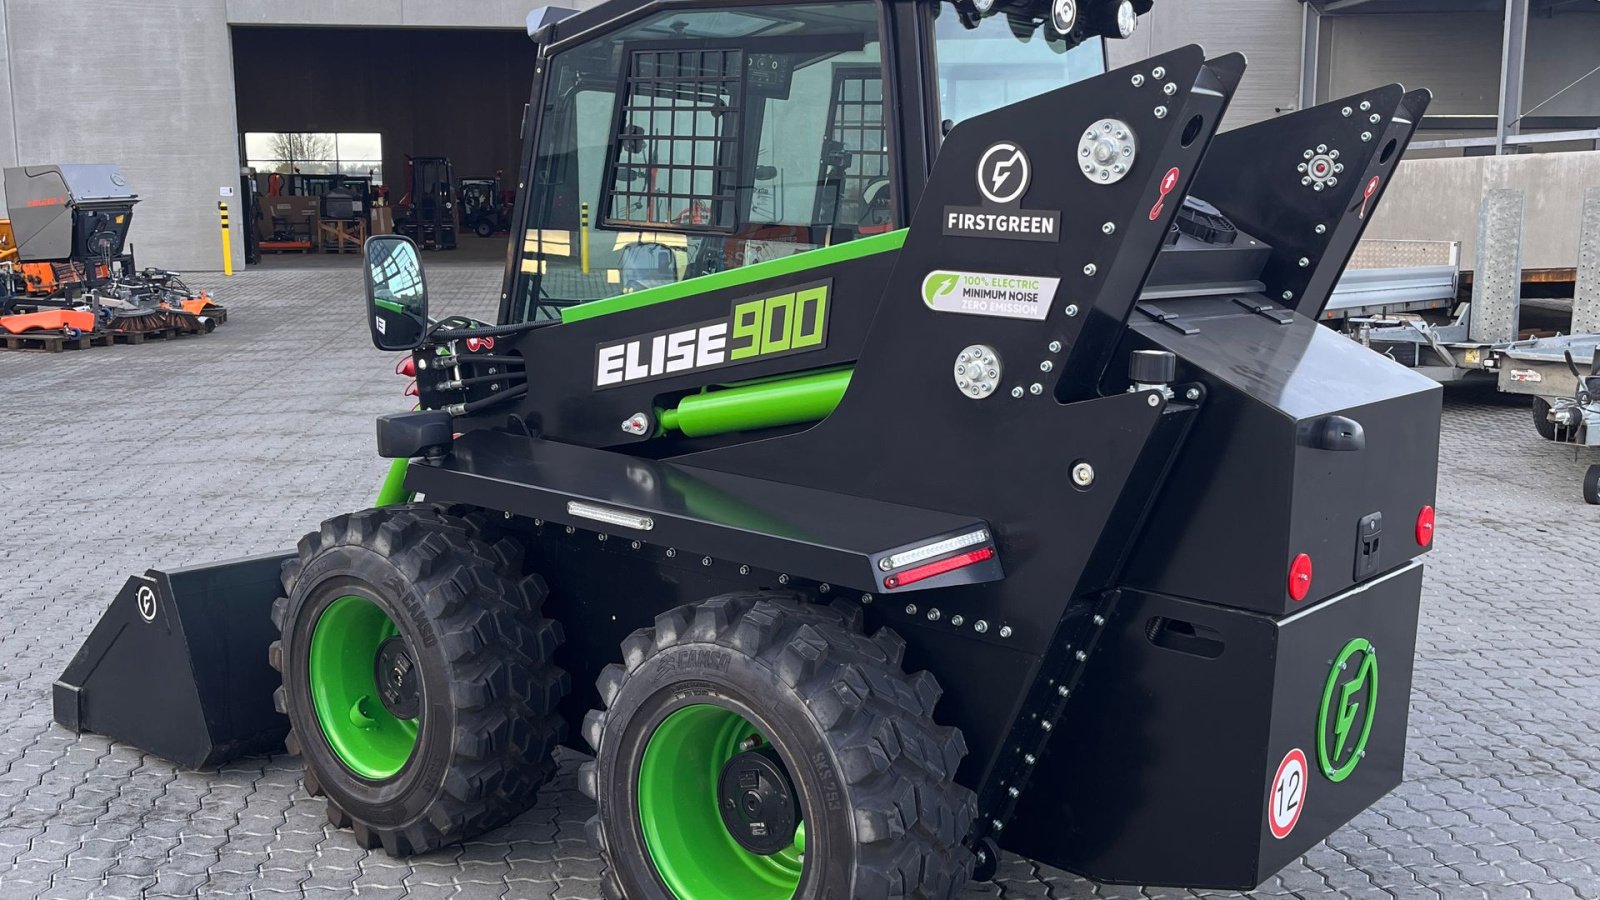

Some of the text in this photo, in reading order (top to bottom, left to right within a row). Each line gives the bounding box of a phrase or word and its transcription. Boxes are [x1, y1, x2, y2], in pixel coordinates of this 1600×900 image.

[947, 212, 1055, 234] FIRSTGREEN
[963, 275, 1039, 290] 100% ELECTRIC
[962, 287, 1039, 303] MINIMUM NOISE
[961, 300, 1038, 316] ZERO EMISSION
[677, 649, 732, 673] CAMSO
[1277, 770, 1300, 817] 12
